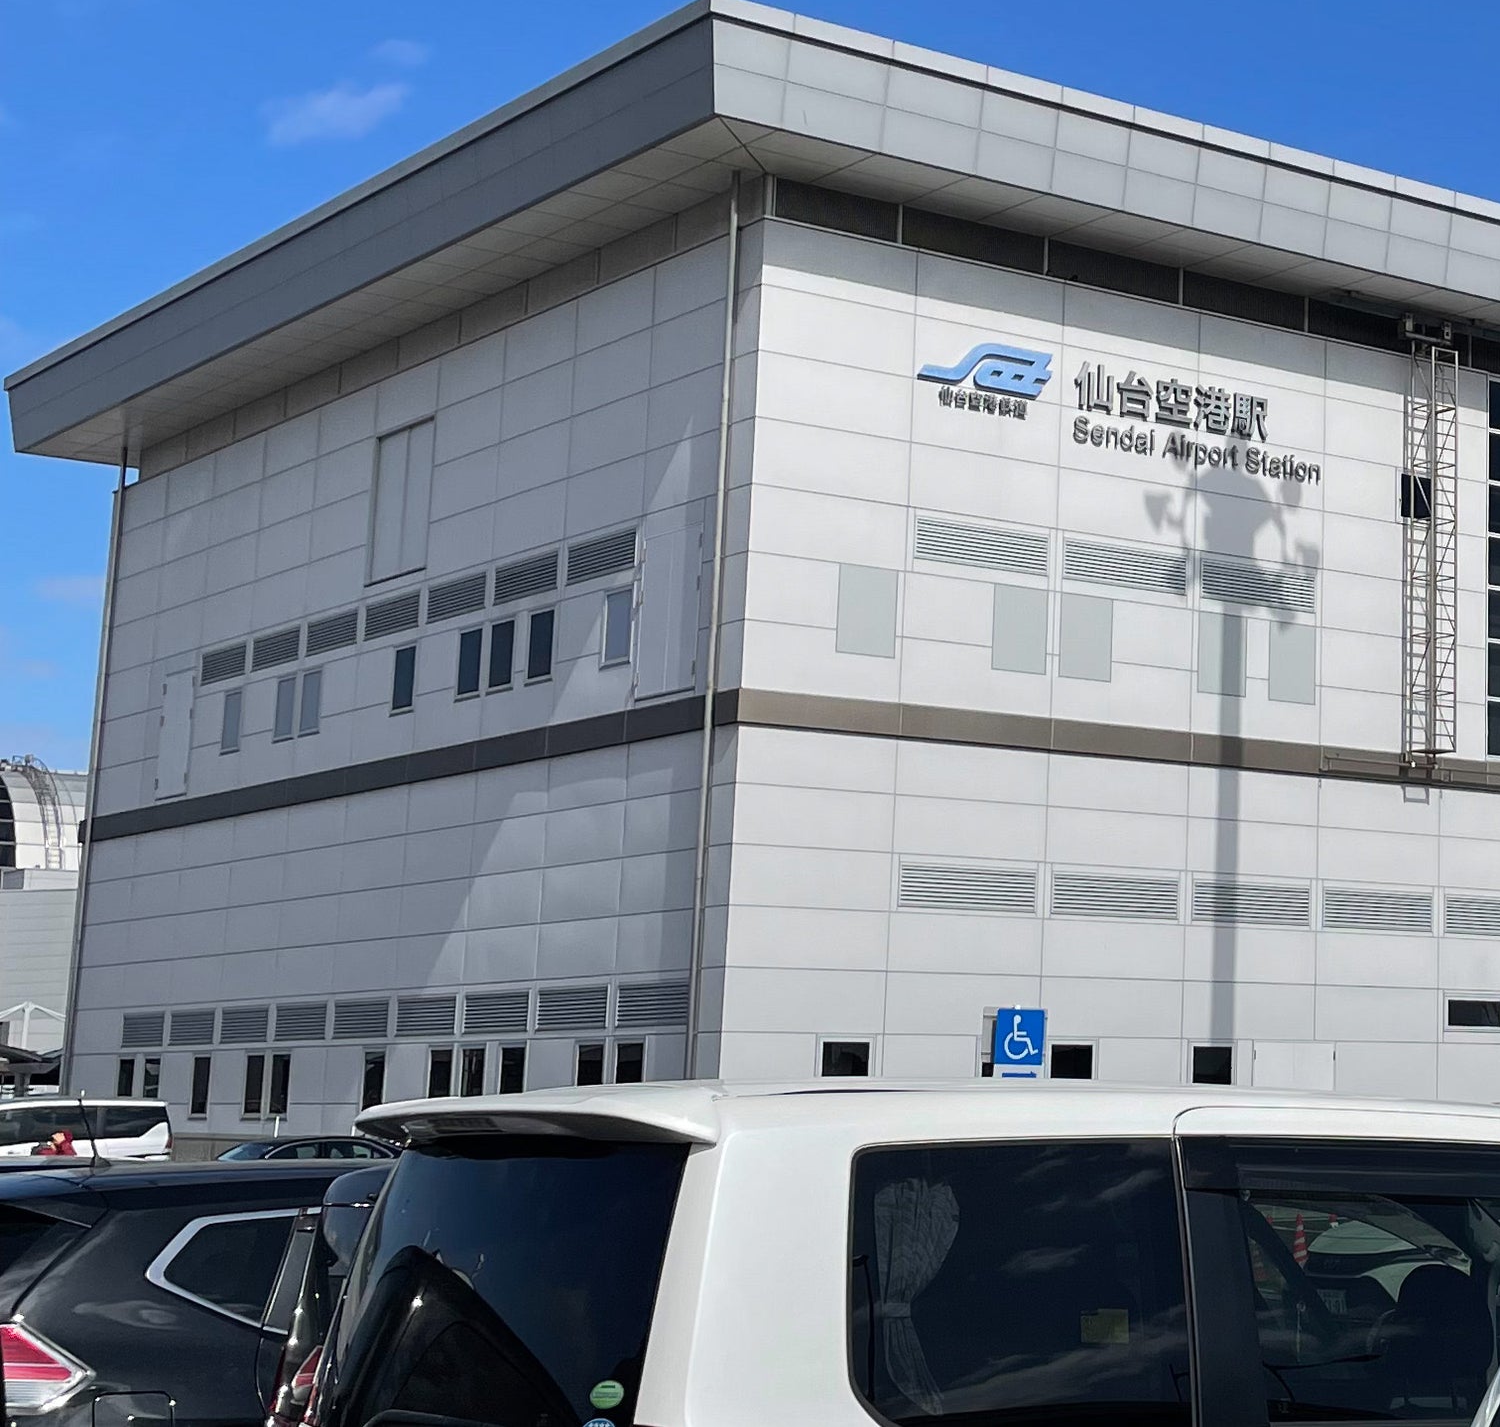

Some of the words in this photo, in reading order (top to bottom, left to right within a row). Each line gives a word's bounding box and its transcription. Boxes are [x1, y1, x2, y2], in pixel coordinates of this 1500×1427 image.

[1074, 360, 1269, 443] 仙台空港駅
[1073, 415, 1156, 456] Sendai
[1161, 430, 1239, 471] Airport
[1245, 446, 1321, 487] Station
